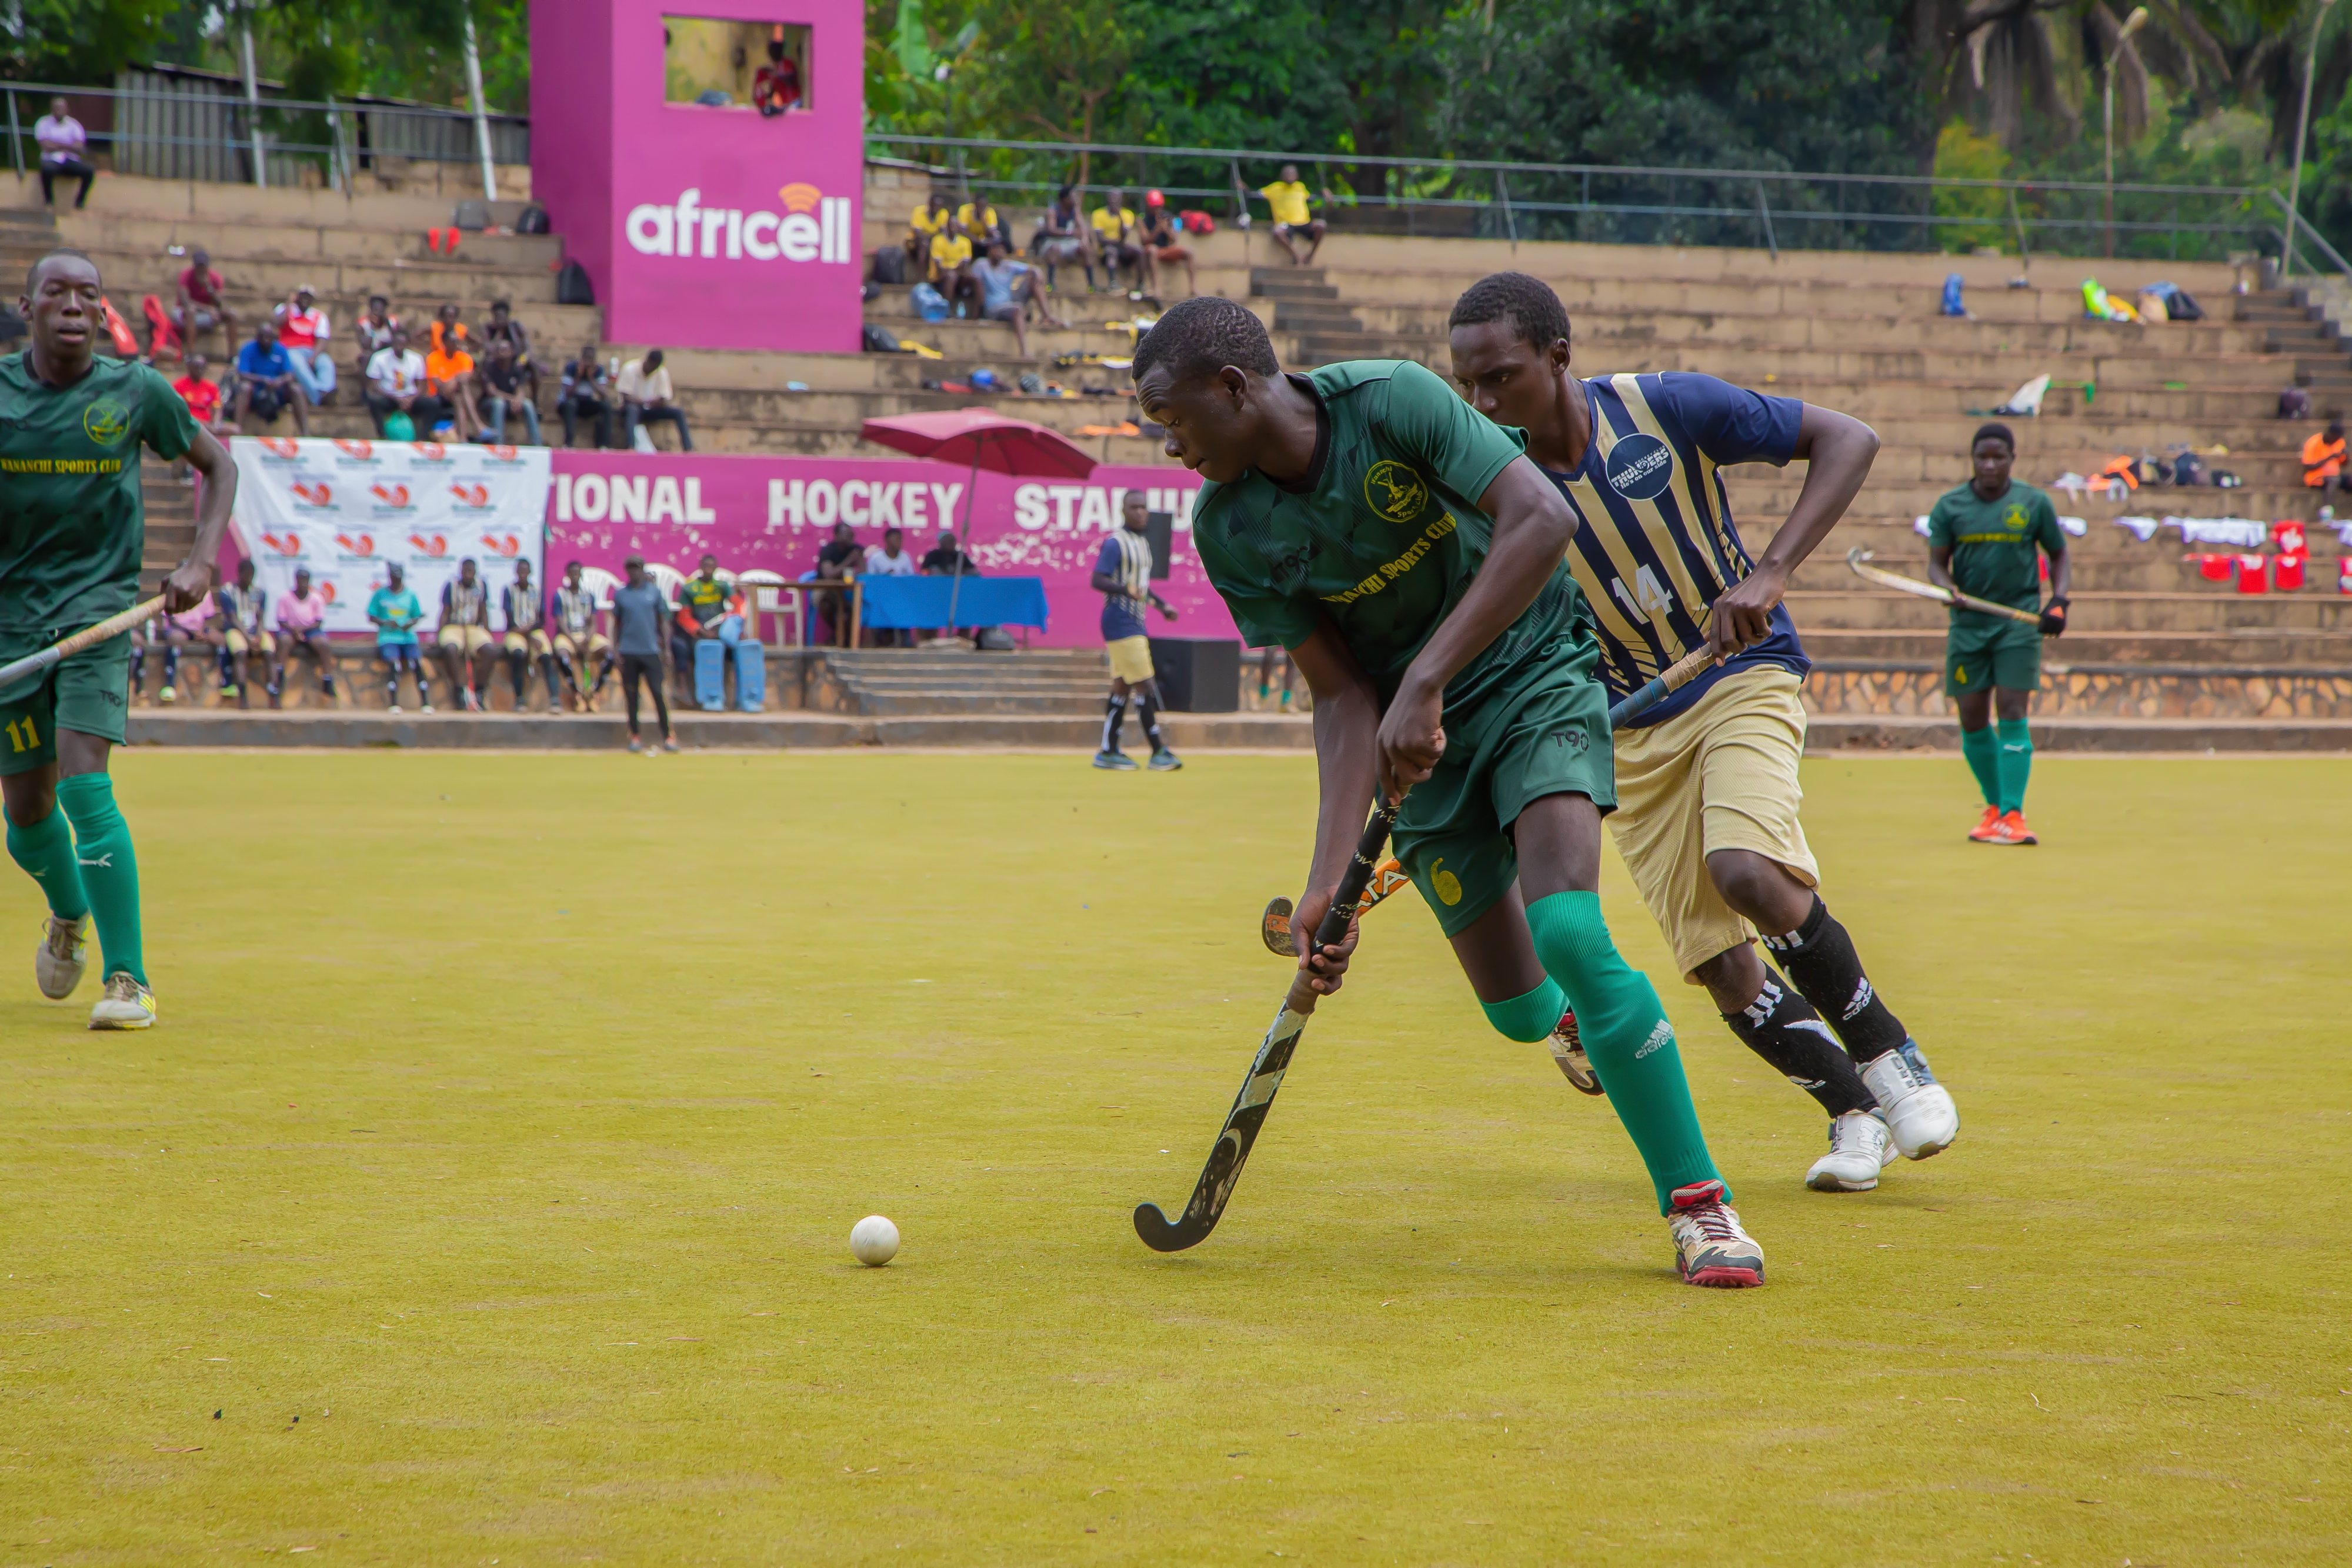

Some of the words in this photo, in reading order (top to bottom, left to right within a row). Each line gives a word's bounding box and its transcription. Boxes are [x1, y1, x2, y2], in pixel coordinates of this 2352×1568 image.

[626, 188, 851, 264] africell
[55, 459, 97, 473] SPORTS
[549, 472, 716, 525] IONAL
[768, 478, 963, 529] HOCKEY
[1379, 538, 1431, 580] SPORTS
[1612, 563, 1673, 625] 14
[5, 715, 41, 753] 11
[1551, 730, 1589, 752] T90
[1430, 858, 1462, 906] 6
